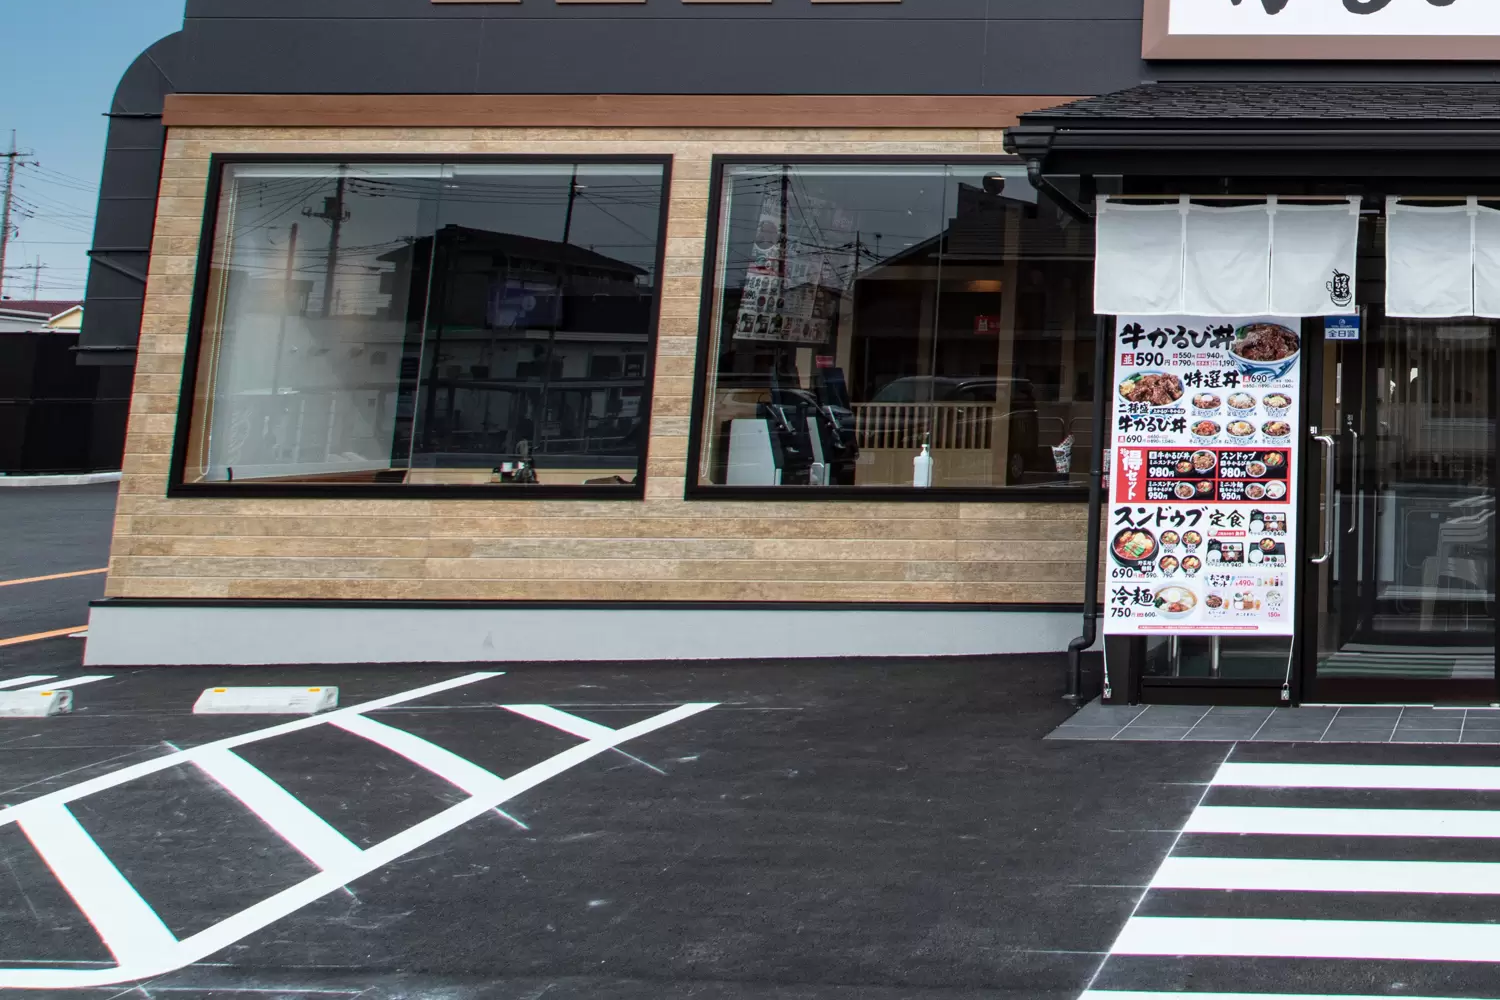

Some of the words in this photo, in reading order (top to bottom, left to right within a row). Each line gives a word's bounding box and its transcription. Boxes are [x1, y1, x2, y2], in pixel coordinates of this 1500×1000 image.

[1119, 322, 1235, 350] 牛かるび丼
[1184, 369, 1240, 388] 特選丼
[1118, 403, 1149, 414] 二種盛
[1118, 414, 1187, 434] 牛かるび丼
[1114, 506, 1208, 527] スンドゥブ
[1209, 509, 1245, 528] 定食
[1111, 585, 1153, 606] 冷麺
